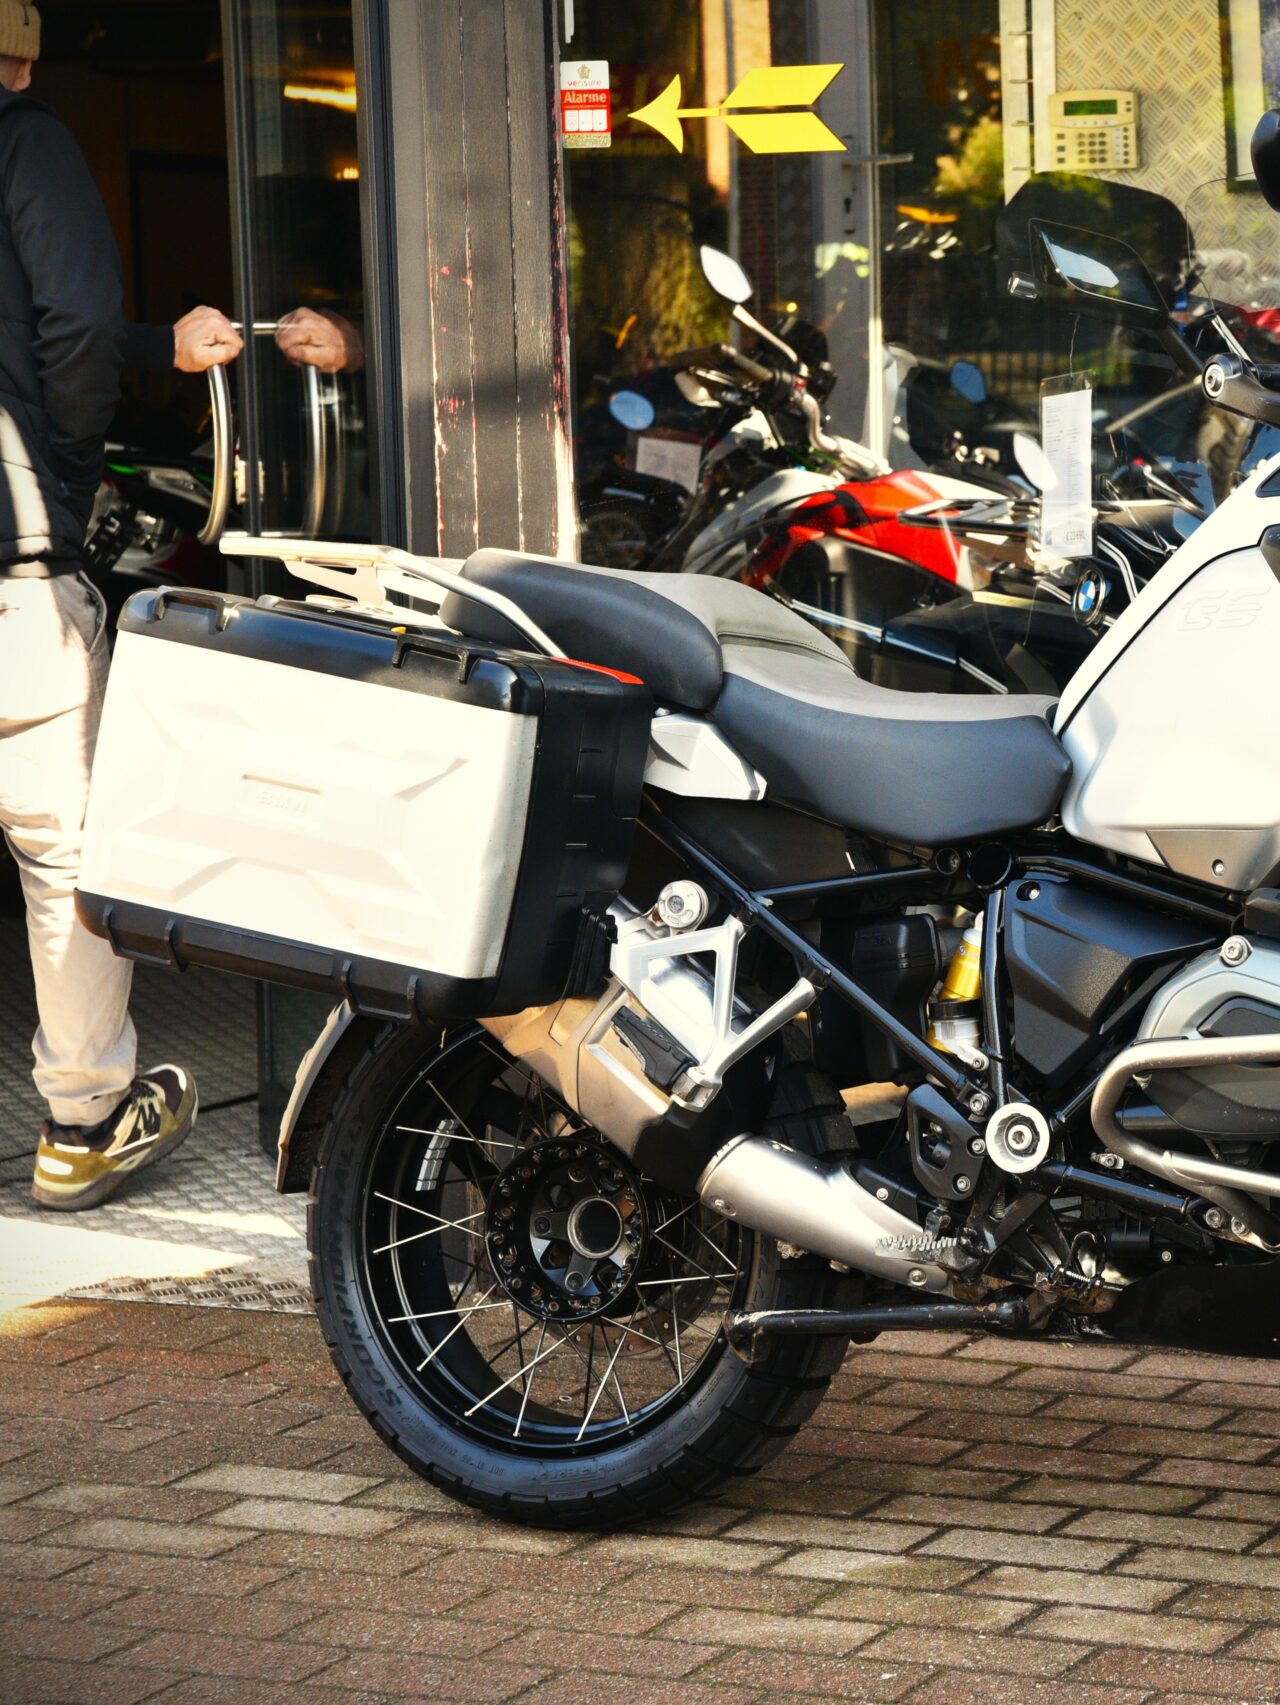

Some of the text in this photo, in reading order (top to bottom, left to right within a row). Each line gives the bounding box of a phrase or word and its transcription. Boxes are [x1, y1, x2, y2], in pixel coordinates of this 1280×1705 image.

[564, 91, 607, 104] Alarme
[1177, 587, 1272, 631] GS
[328, 1229, 403, 1414] SCORPION
